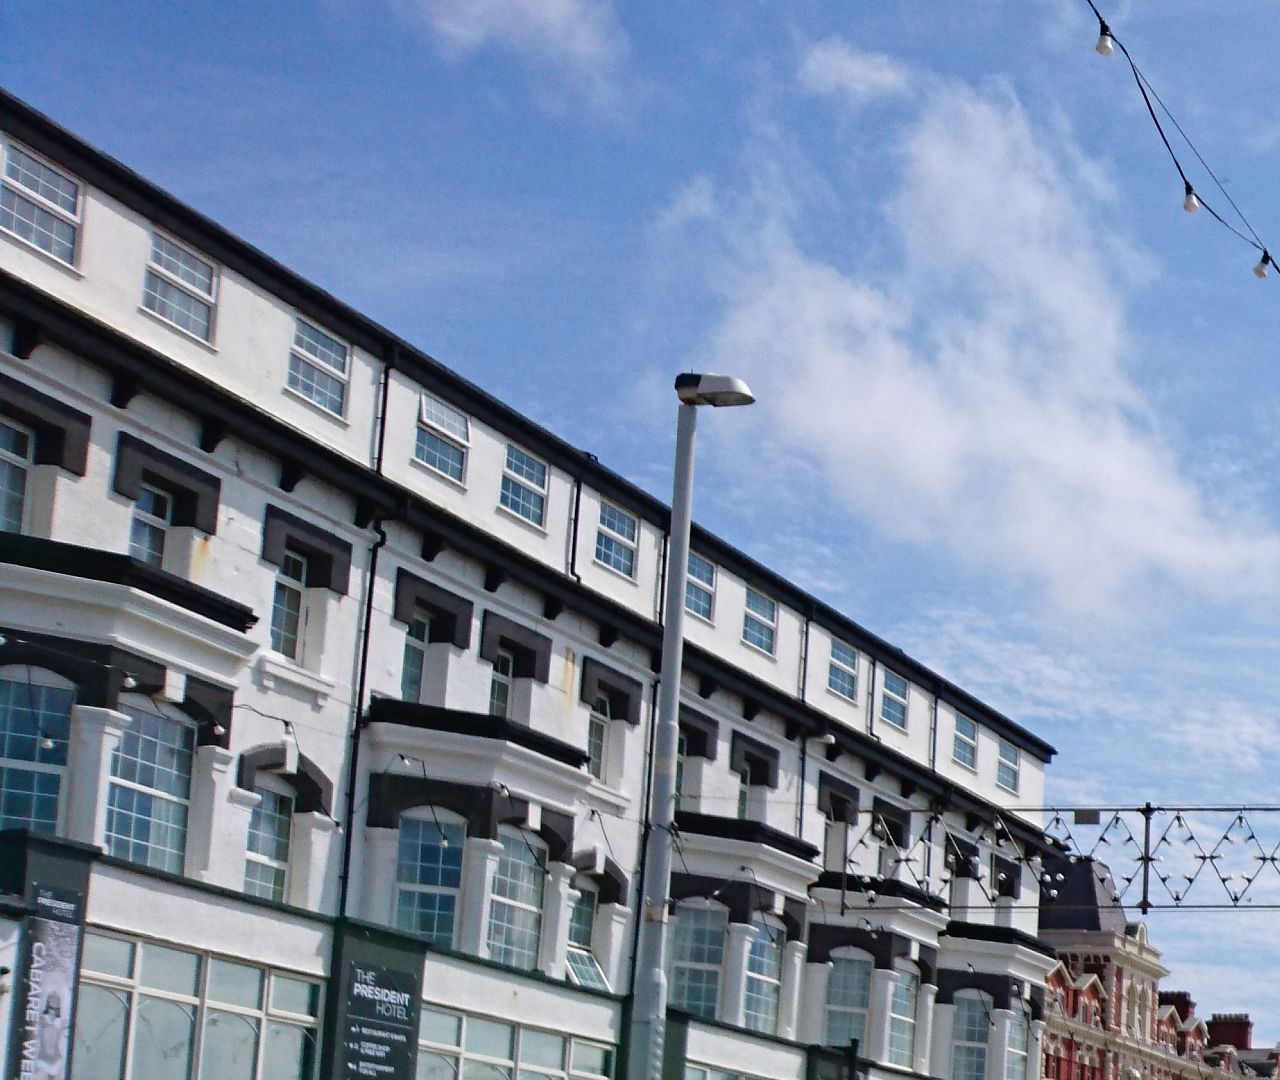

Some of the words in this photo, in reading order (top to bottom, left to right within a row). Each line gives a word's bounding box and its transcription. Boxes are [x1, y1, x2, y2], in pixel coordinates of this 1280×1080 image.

[24, 941, 46, 1031] CABARET
[356, 968, 376, 985] THE
[353, 982, 411, 1007] PRESIDENT
[376, 1001, 408, 1020] HOTEL
